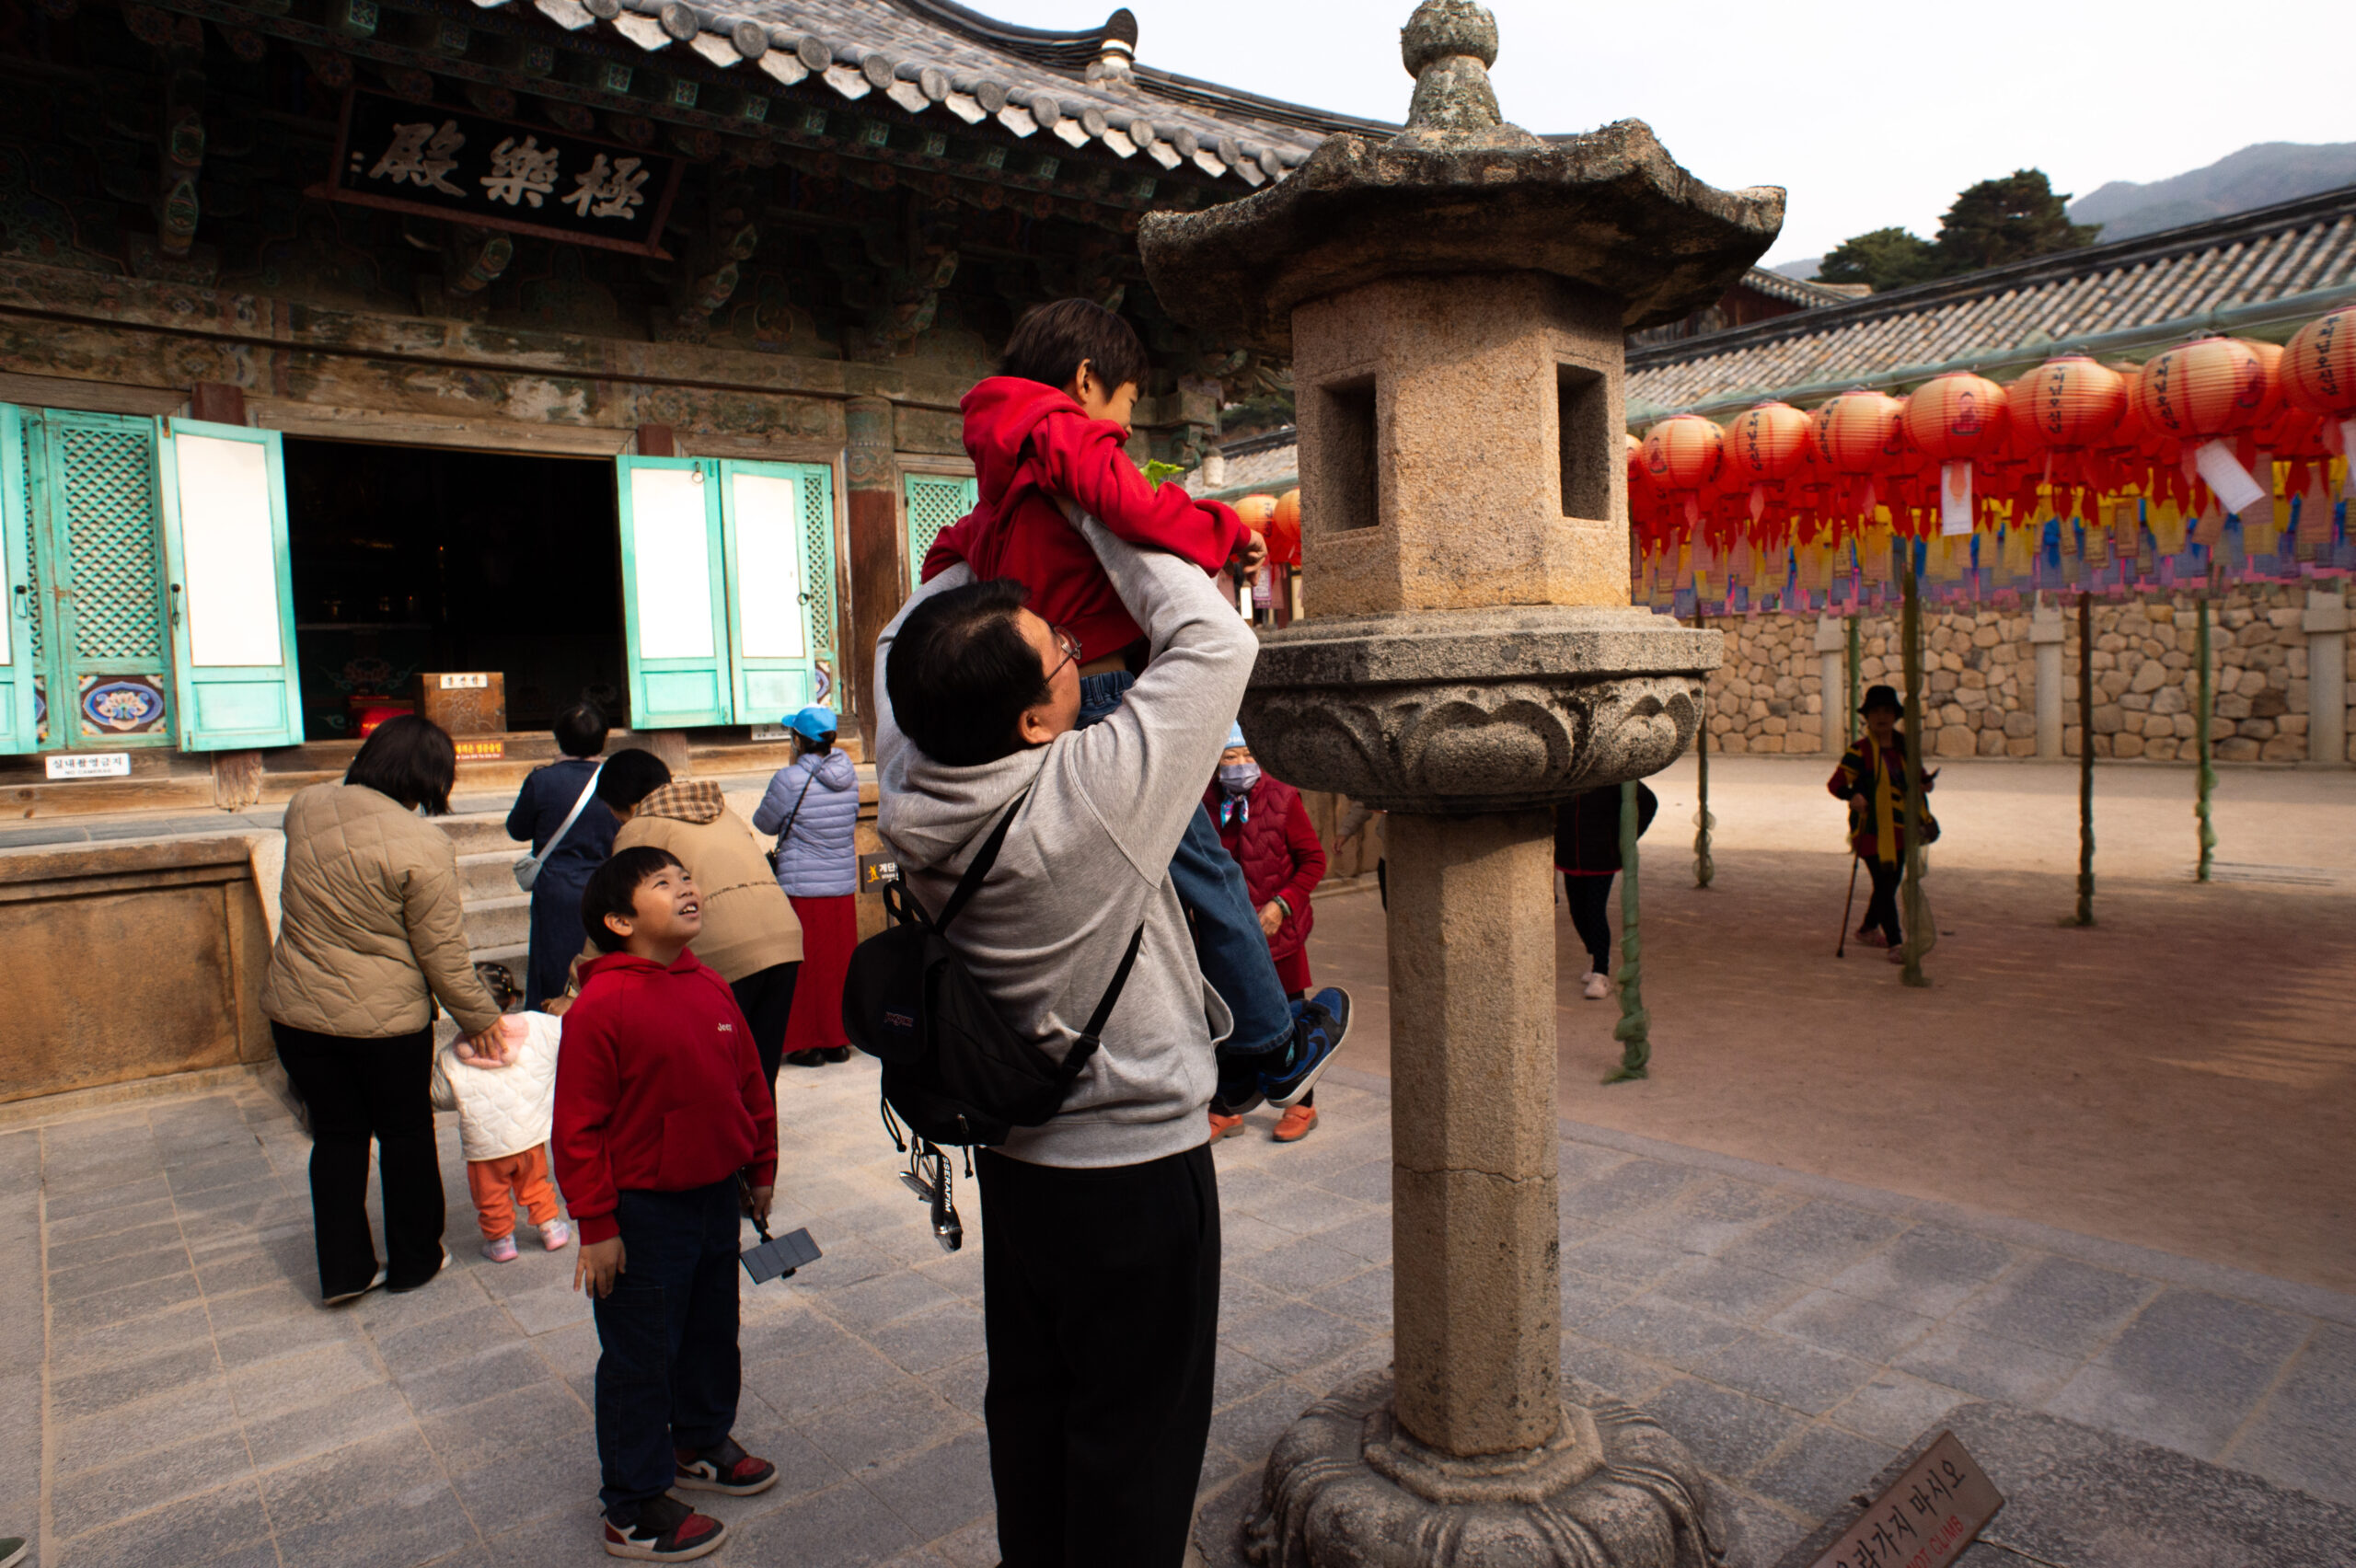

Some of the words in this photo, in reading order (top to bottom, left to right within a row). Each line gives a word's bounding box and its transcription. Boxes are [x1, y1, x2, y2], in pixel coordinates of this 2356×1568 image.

[369, 119, 651, 221] 極樂殿
[1836, 1505, 1918, 1568] 라가지
[1910, 1459, 1966, 1516] 마시오
[1929, 1515, 1965, 1556] CLIMB
